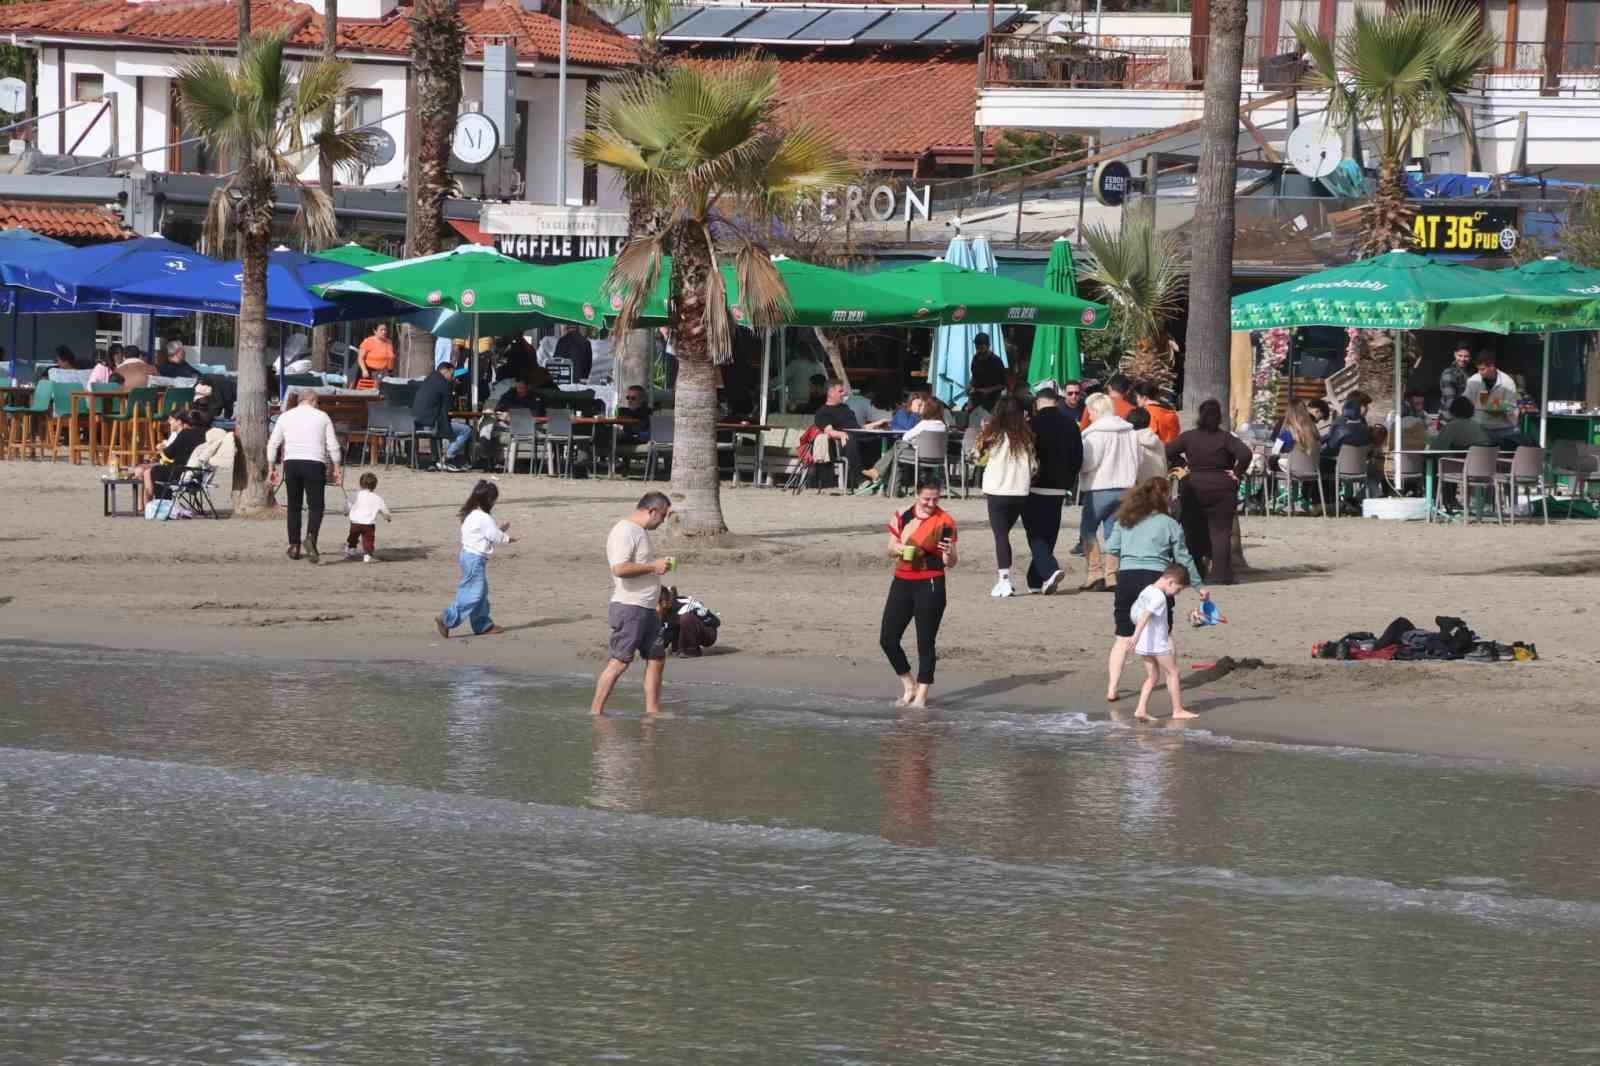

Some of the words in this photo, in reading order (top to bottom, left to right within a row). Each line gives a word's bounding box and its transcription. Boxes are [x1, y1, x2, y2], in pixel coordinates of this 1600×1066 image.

[501, 234, 573, 258] WAFFLE
[578, 235, 610, 258] INN
[1474, 231, 1499, 250] PUB
